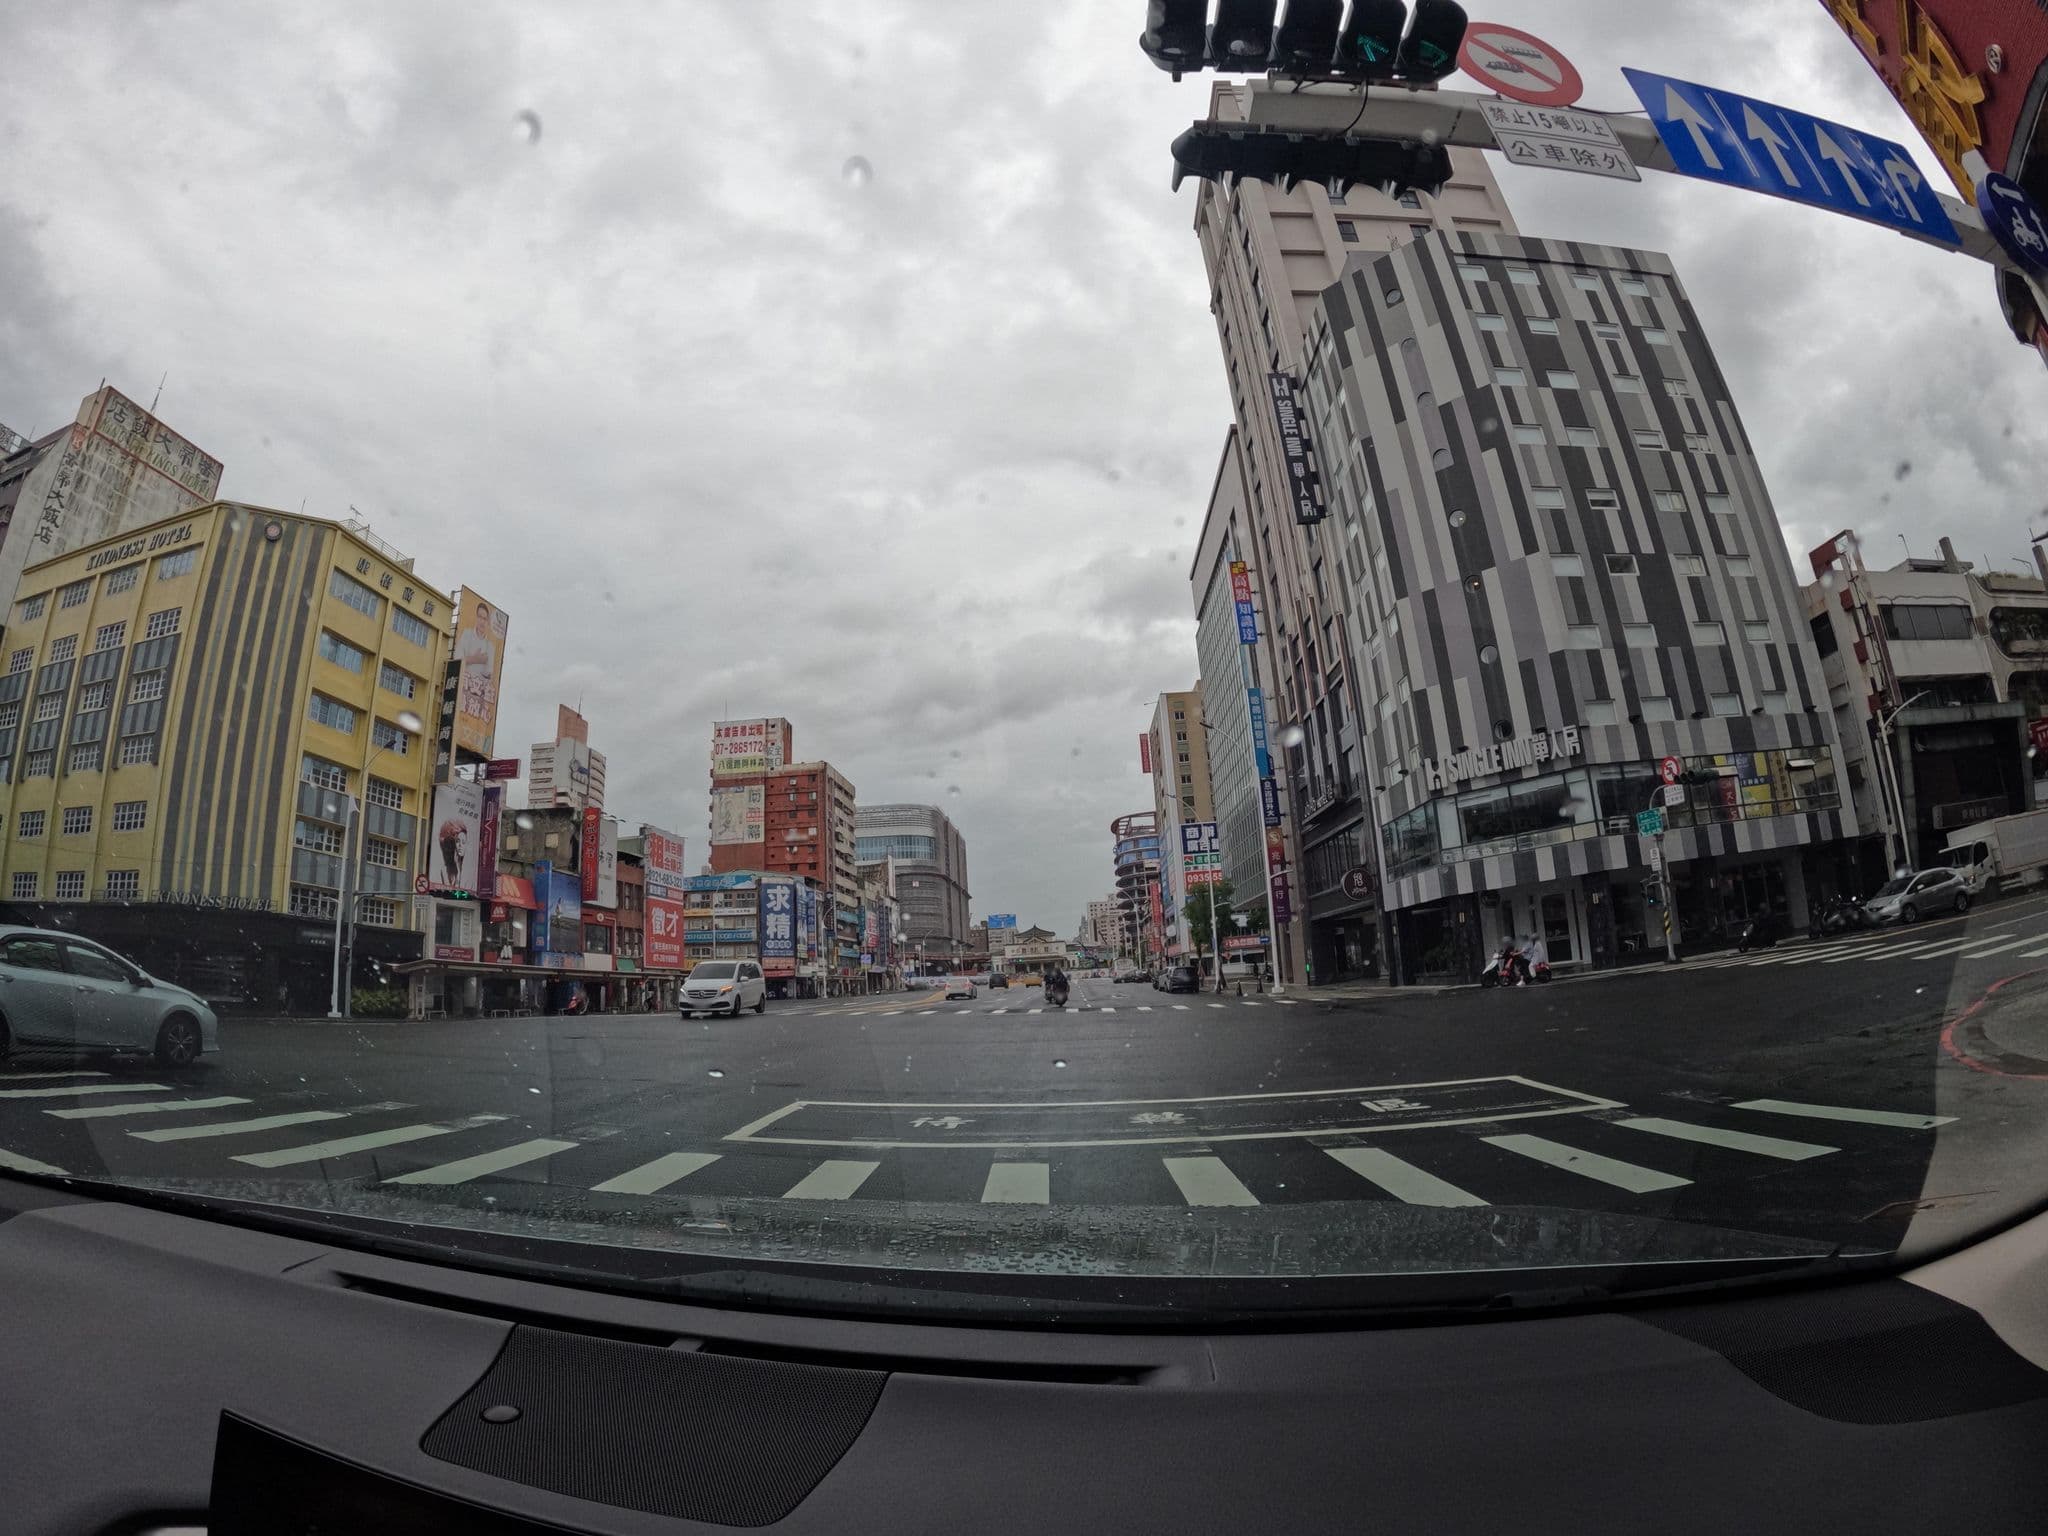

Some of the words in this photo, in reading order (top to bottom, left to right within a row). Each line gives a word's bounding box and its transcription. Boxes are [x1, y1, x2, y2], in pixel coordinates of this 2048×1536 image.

[1488, 105, 1610, 138] 禁止15噸以上
[1511, 140, 1627, 173] 公車除外
[1277, 400, 1299, 435] SINGLE
[1285, 437, 1303, 457] INN
[86, 538, 147, 571] KINDNESS
[148, 523, 193, 552] HOTEL
[1449, 744, 1503, 783] SINGLE
[1502, 738, 1532, 769] INN
[156, 890, 223, 908] KINDNESS
[228, 898, 276, 912] HOTEL
[766, 885, 791, 940] 求精
